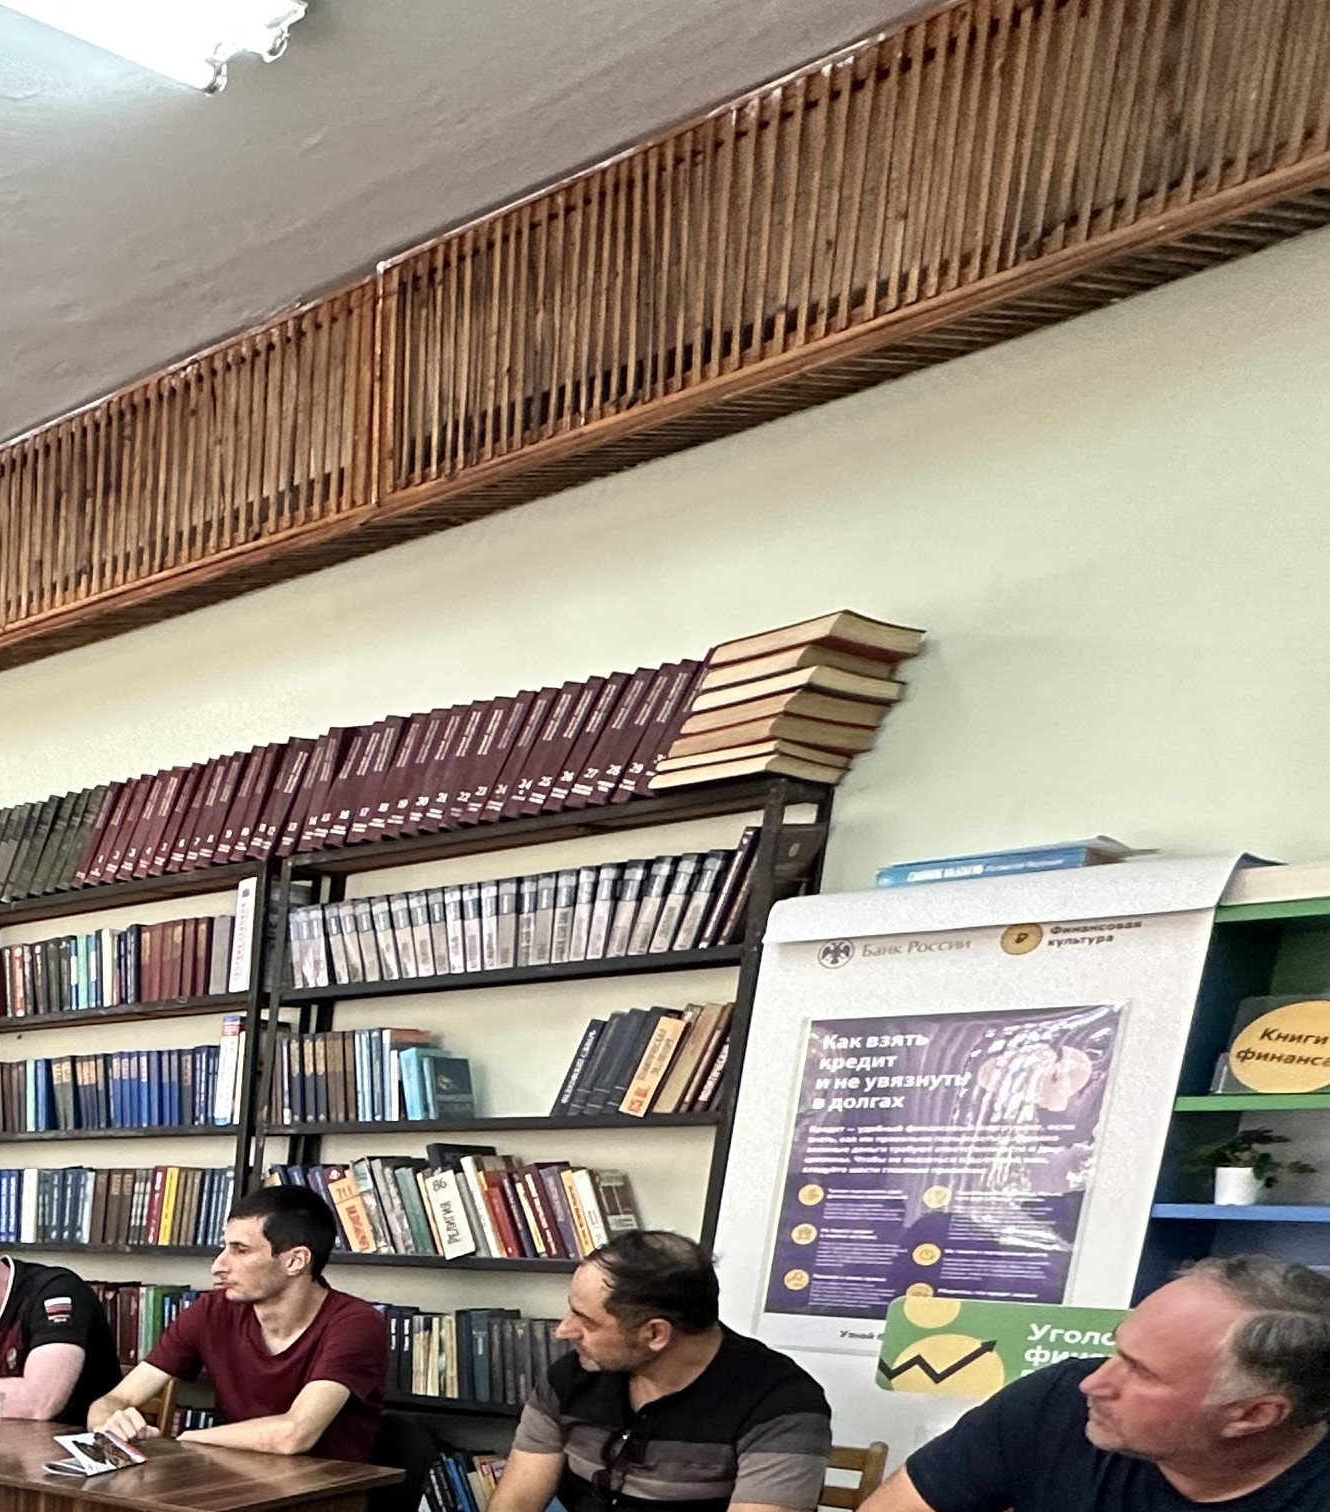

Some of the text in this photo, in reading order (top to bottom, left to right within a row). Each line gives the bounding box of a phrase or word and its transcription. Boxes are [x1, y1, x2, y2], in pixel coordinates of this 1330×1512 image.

[1049, 920, 1143, 936] Финансовая
[861, 939, 972, 958] Банк России
[1047, 934, 1115, 947] культура
[822, 1033, 930, 1049] Как взять
[1259, 1027, 1329, 1045] Книги
[819, 1055, 898, 1073] кредит
[815, 1073, 970, 1092] и не увязнуть
[812, 1096, 905, 1112] в долгах
[439, 1201, 461, 1246] РЕЛИГИЯ
[1027, 1323, 1116, 1346] Уголо
